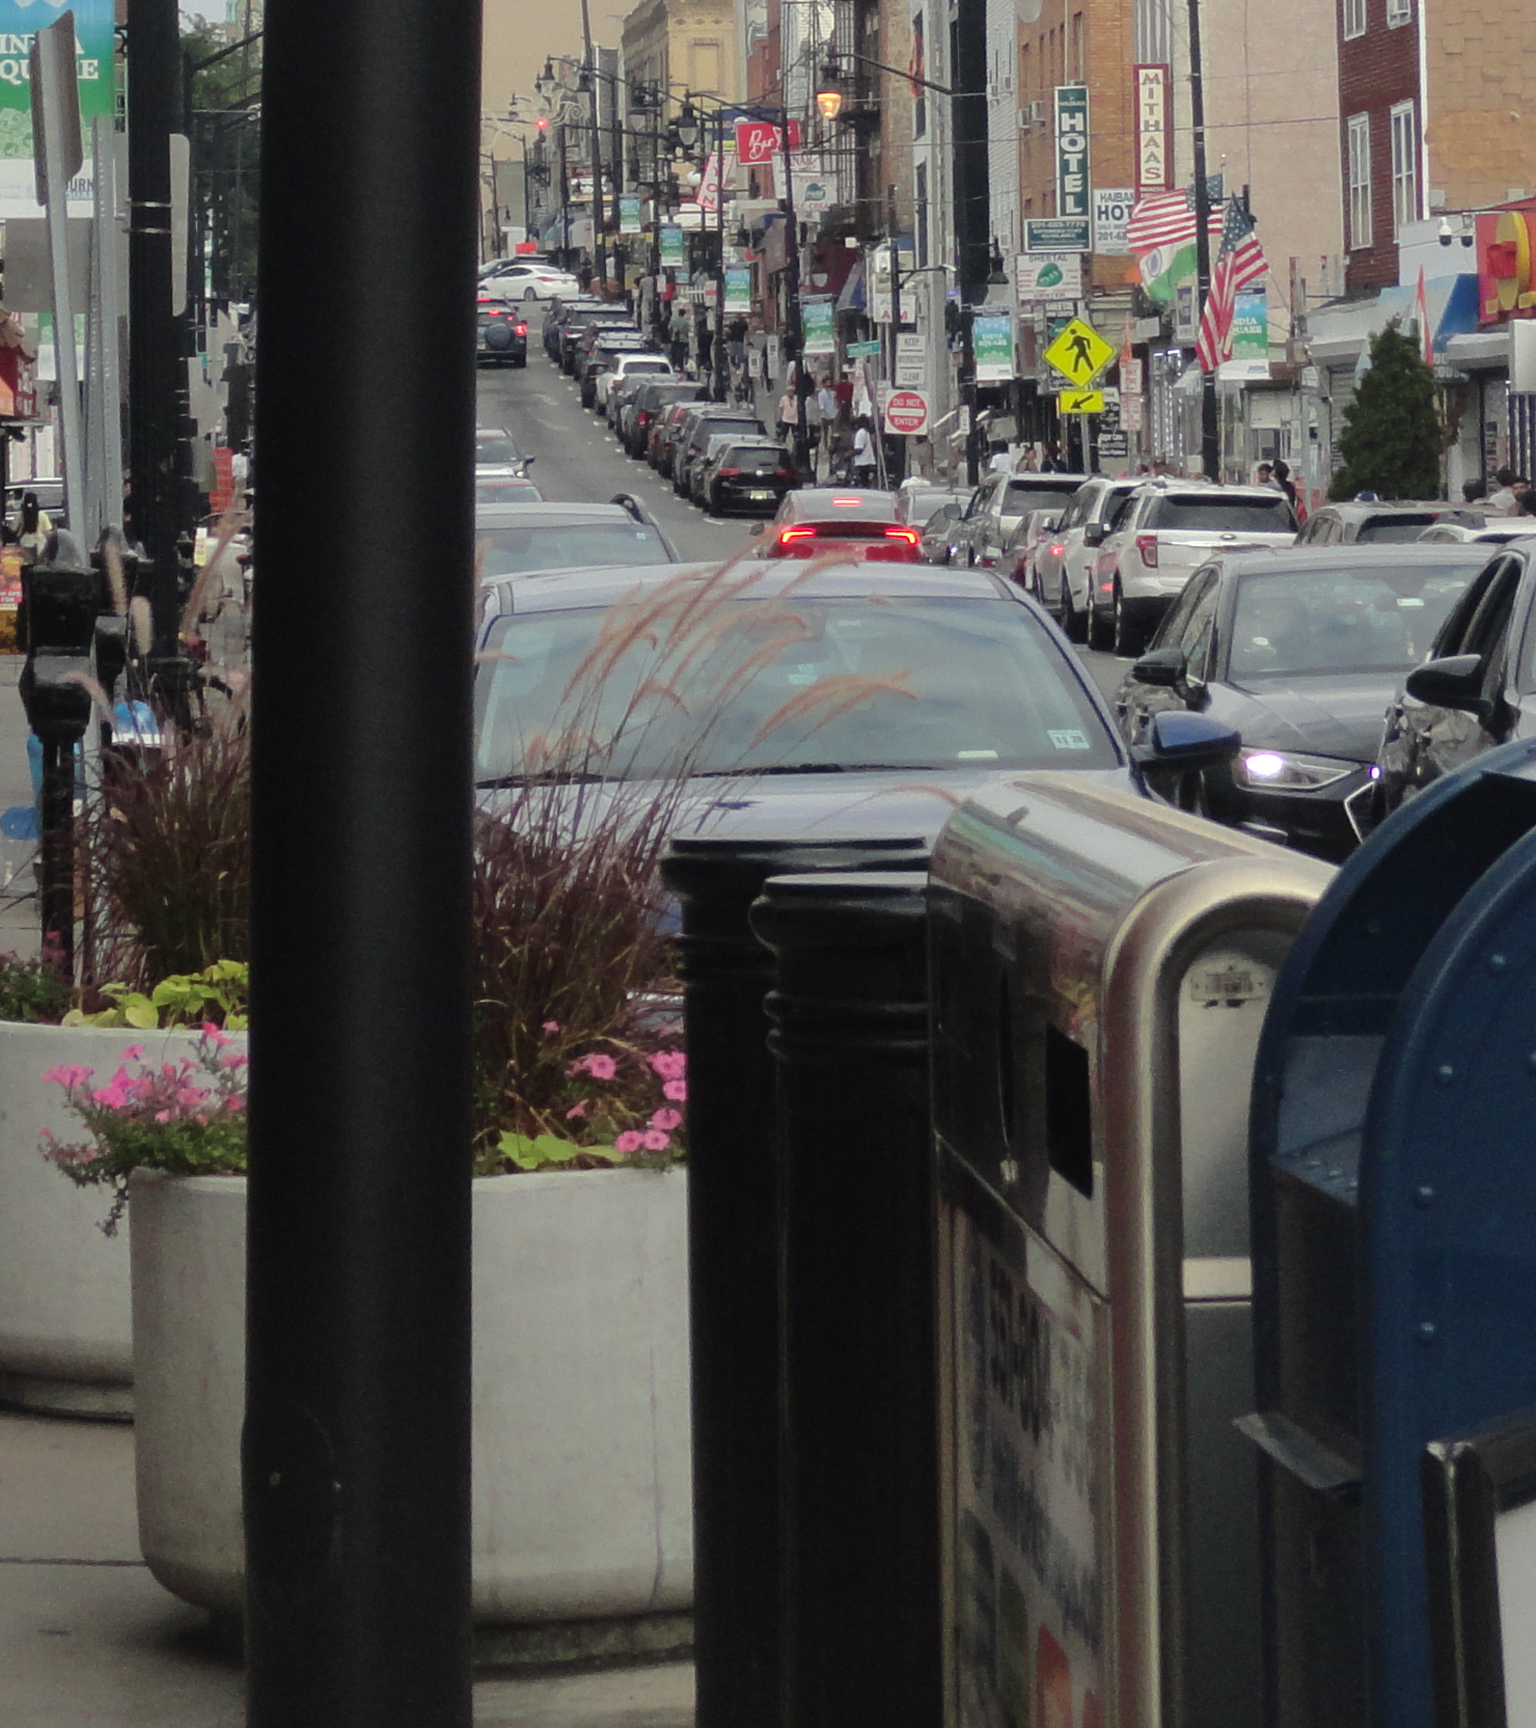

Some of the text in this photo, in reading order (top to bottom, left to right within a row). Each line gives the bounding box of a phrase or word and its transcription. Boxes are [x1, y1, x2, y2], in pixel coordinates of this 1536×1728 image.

[1142, 73, 1162, 180] MITHAAS
[1061, 112, 1085, 214] HOTEL
[893, 398, 920, 406] DO NOT
[894, 417, 918, 426] ENTER
